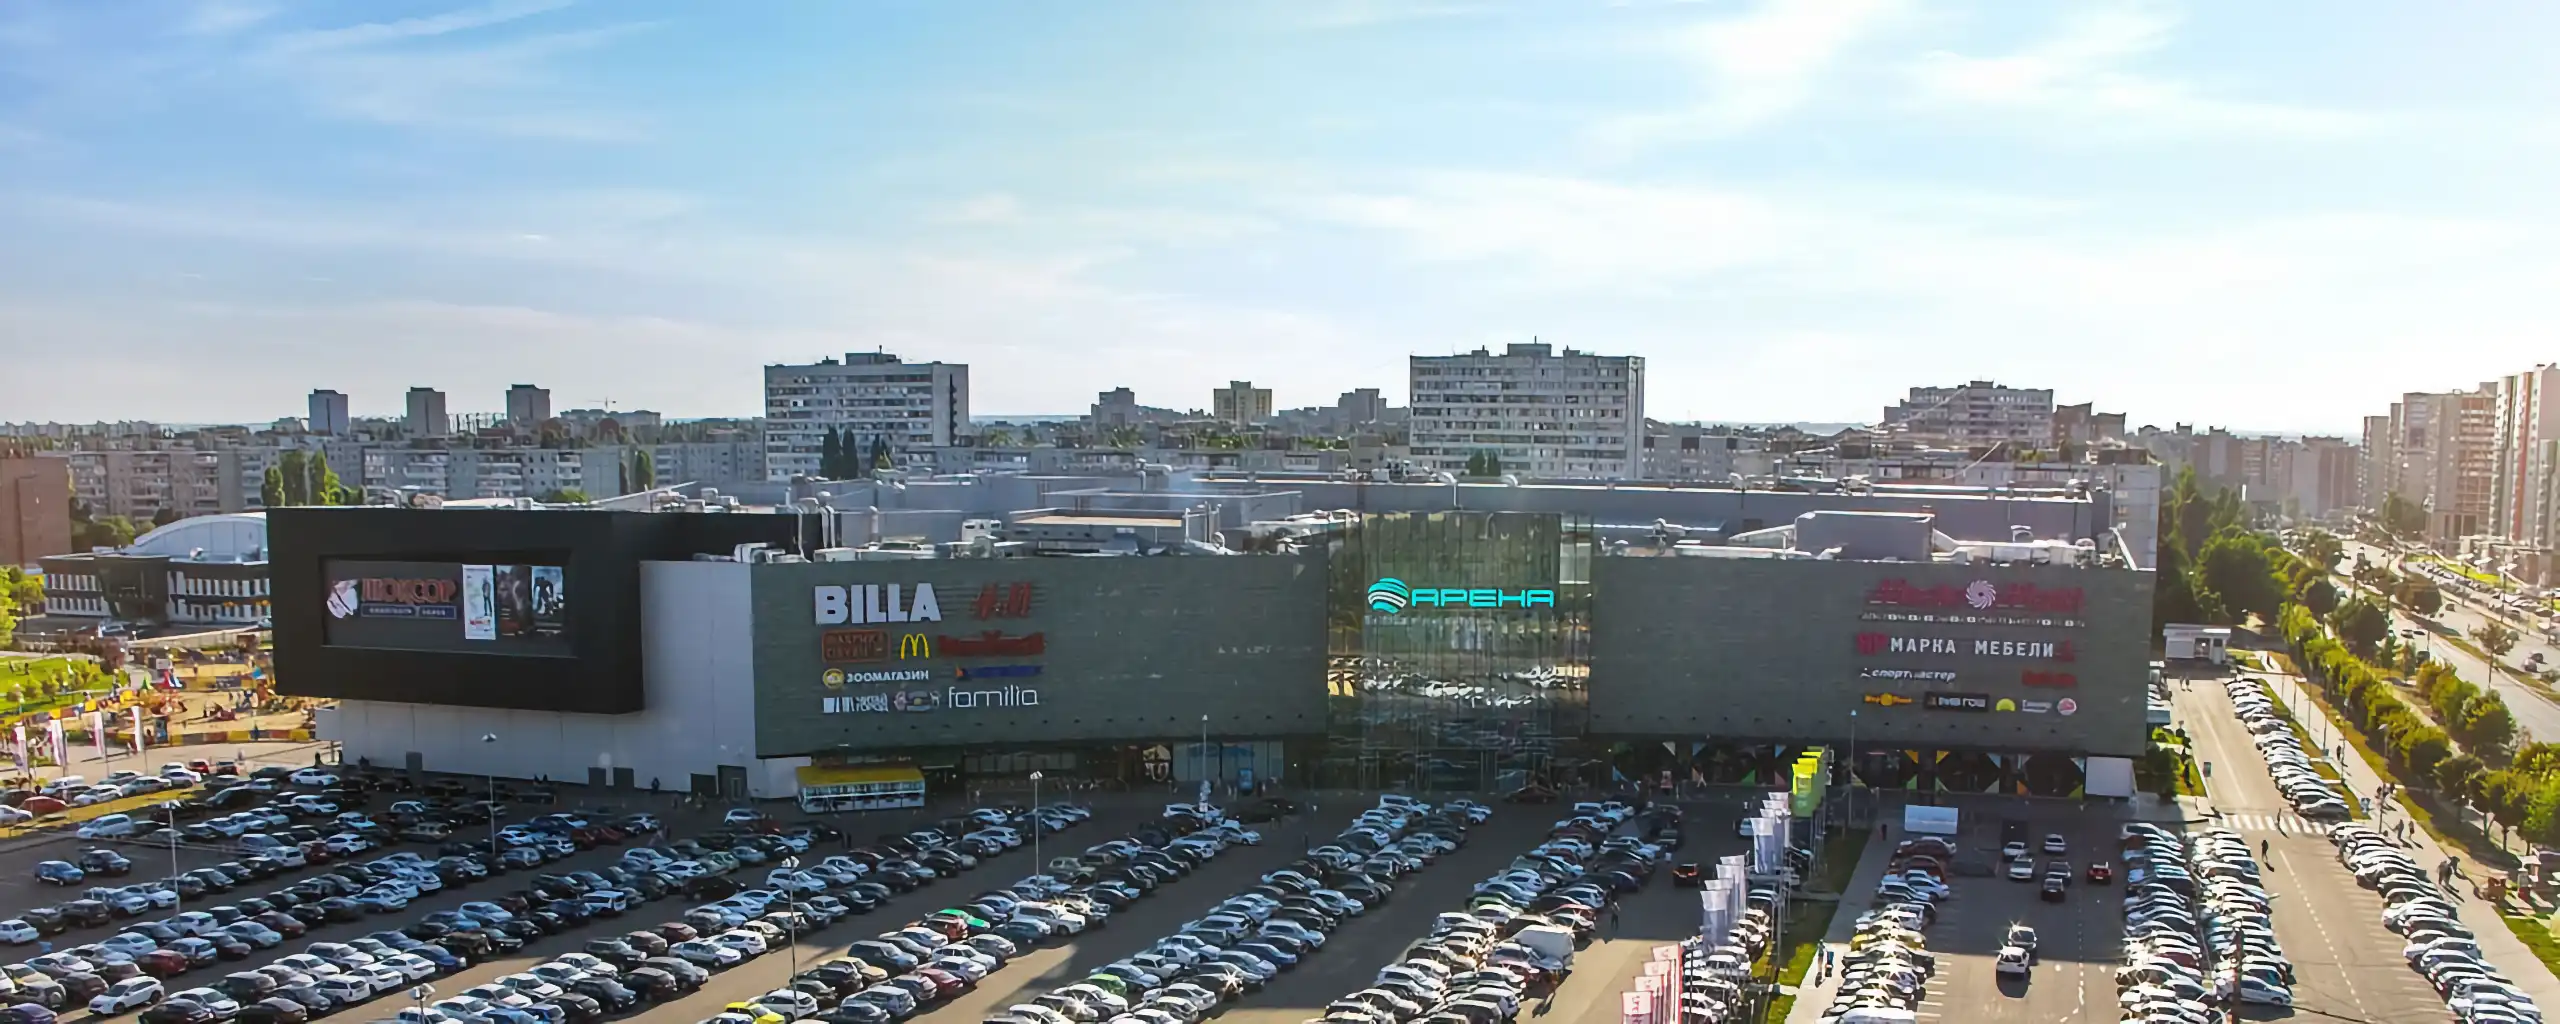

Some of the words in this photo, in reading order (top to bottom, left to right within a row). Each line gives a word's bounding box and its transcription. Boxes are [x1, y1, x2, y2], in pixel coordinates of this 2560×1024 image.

[815, 583, 941, 624] BILLA
[1411, 588, 1555, 608] АРЕНА
[1890, 637, 1956, 655] МАРКА
[1974, 640, 2054, 658] МЕБЕЛИ
[846, 671, 929, 683] ЗООМАГАЗИН
[948, 685, 1039, 709] familia
